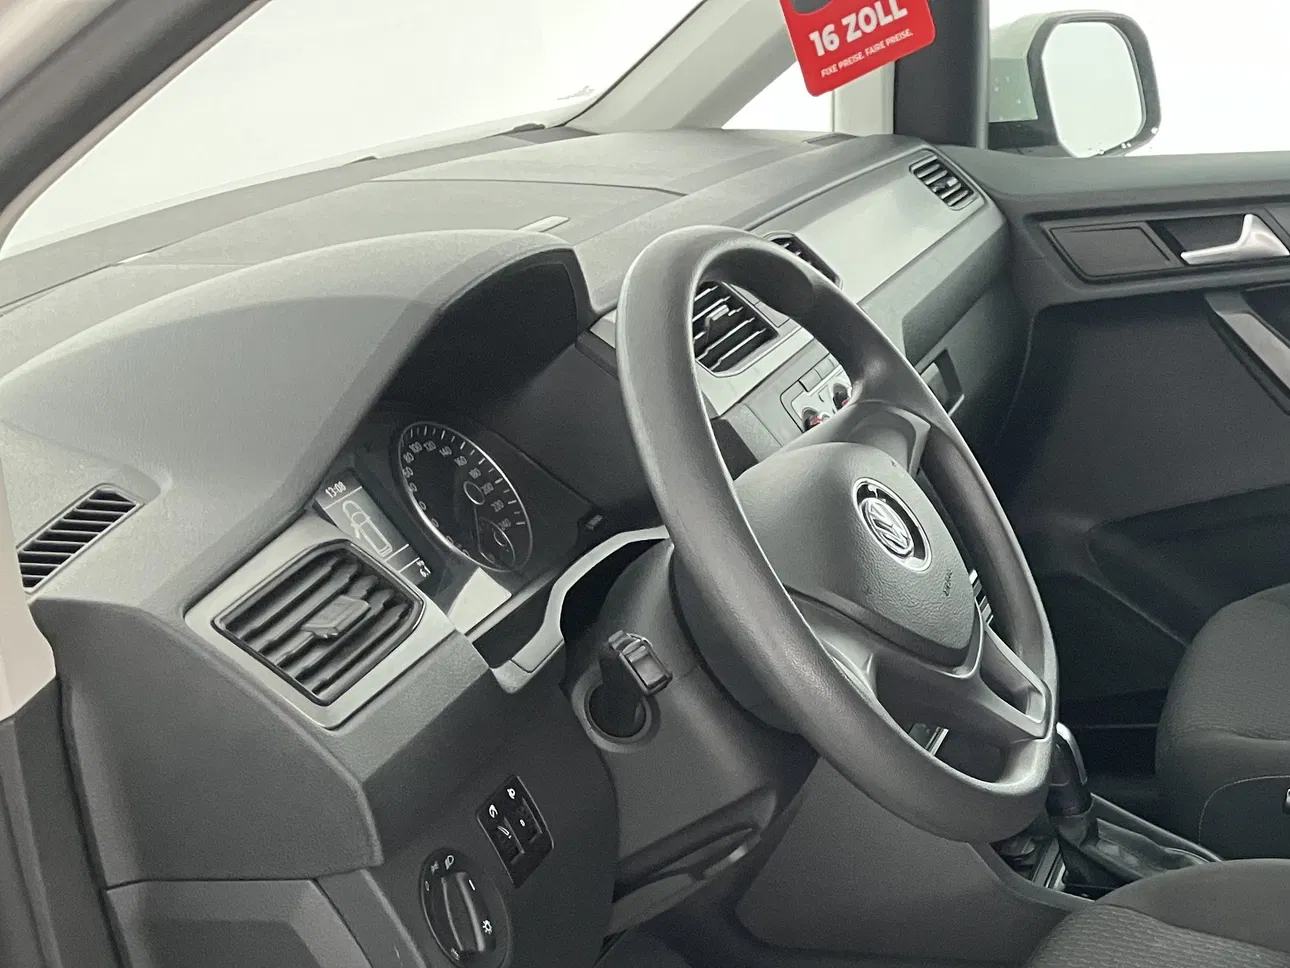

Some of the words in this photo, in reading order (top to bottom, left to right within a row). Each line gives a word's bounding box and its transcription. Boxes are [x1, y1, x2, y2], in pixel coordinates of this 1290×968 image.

[808, 24, 840, 57] 16
[841, 0, 908, 43] ZOLL
[820, 64, 838, 78] FIXE
[864, 41, 886, 57] FAIRE
[408, 441, 423, 454] 100
[440, 445, 453, 457] 140
[403, 451, 415, 463] 80
[454, 456, 468, 467] 160
